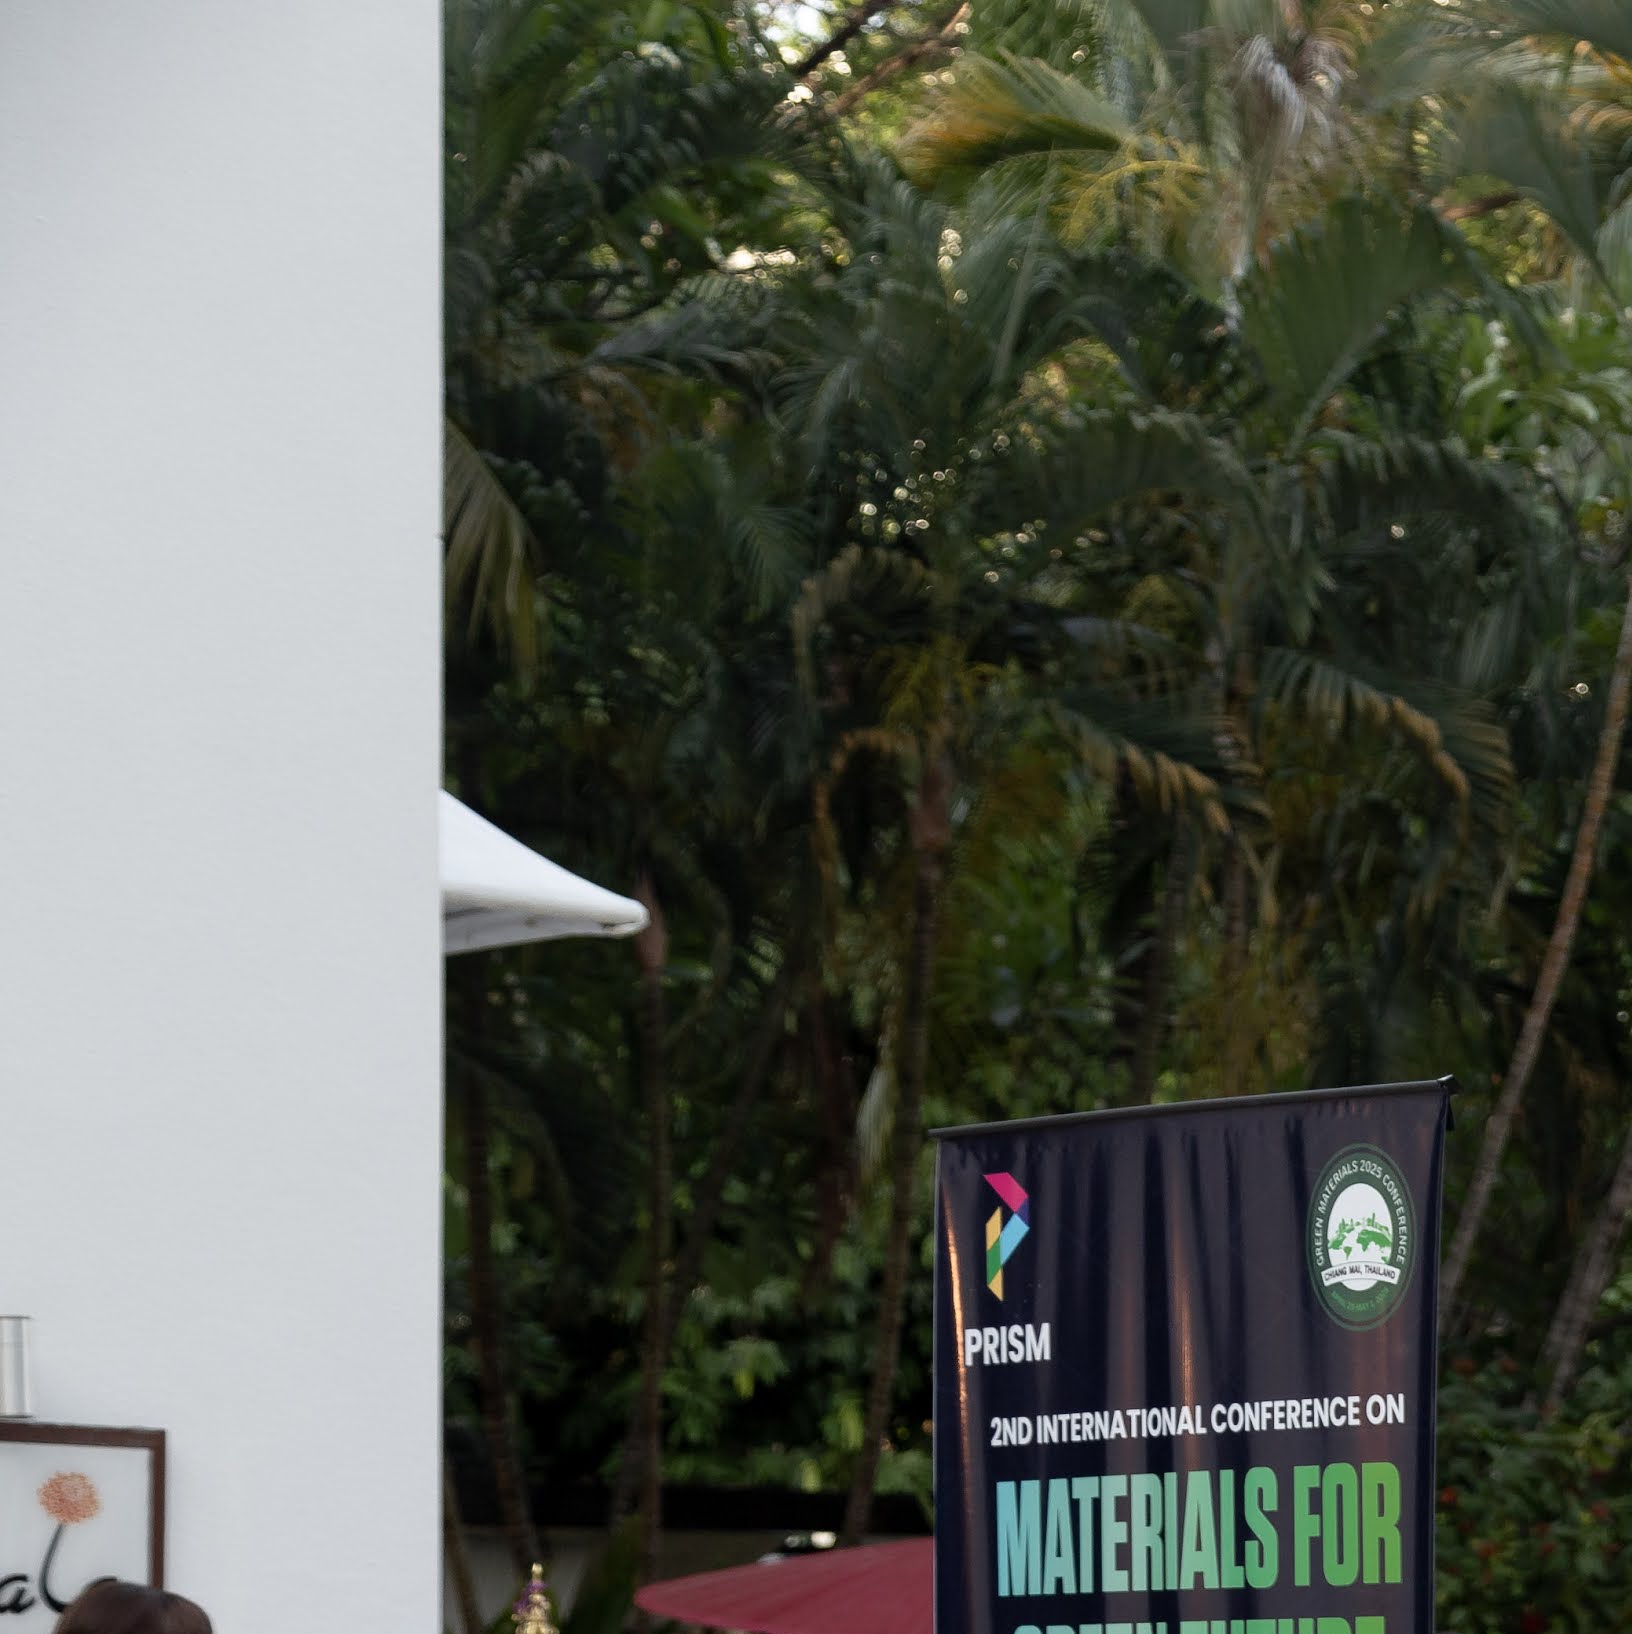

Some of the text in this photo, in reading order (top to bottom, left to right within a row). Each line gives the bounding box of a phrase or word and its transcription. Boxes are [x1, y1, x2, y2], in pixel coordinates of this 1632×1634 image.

[1315, 1159, 1408, 1267] GREEN MATERIALS 2025 CONFERENCE
[1324, 1266, 1347, 1282] CHIANG
[1364, 1266, 1396, 1280] THAILAND
[964, 1322, 1051, 1366] PRISM
[990, 1393, 1405, 1447] 2ND INTERNATIONAL CONFERENCE ON
[996, 1461, 1402, 1598] MATERIALS FOR
